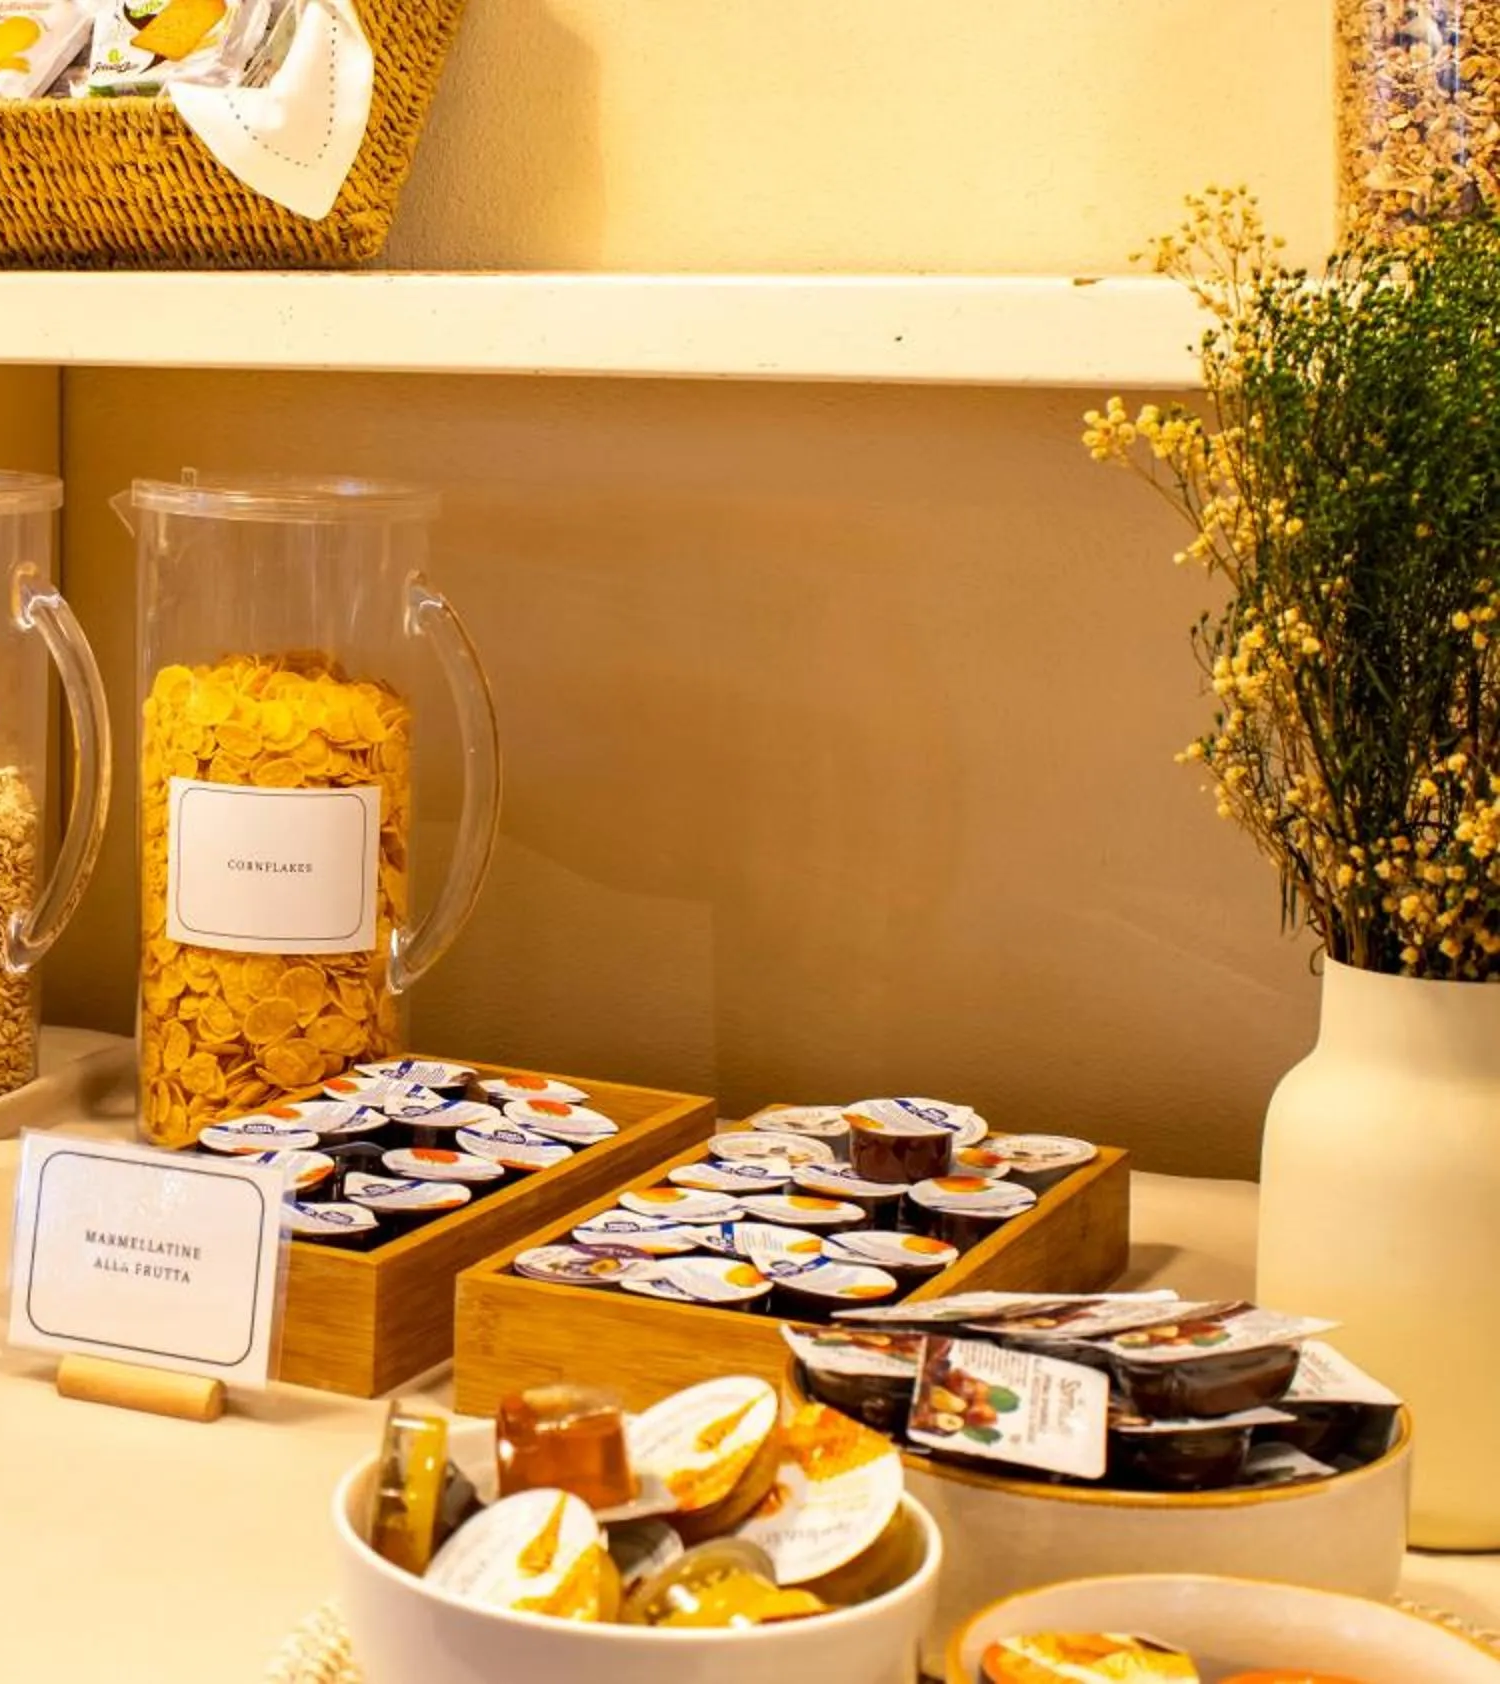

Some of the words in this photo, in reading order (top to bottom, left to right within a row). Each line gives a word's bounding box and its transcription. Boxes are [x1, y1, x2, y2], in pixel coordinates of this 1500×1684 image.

[227, 859, 313, 873] CORNFLAKES
[85, 1230, 201, 1260] MARMELLATINE
[135, 1263, 191, 1284] FRUTTA
